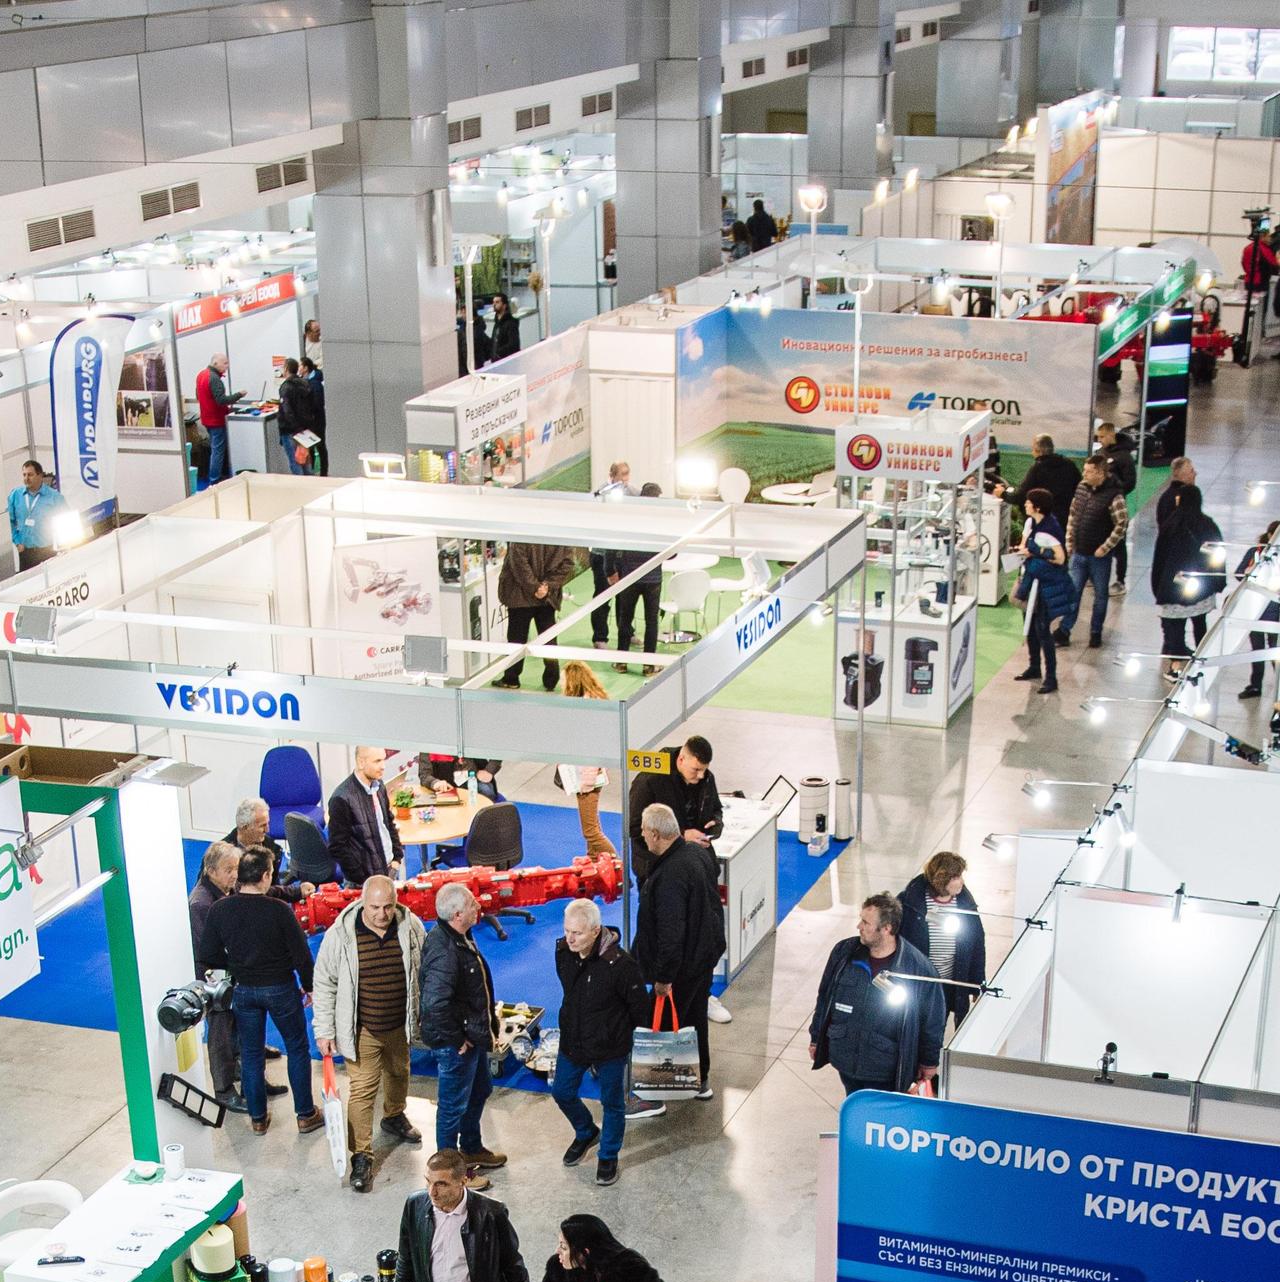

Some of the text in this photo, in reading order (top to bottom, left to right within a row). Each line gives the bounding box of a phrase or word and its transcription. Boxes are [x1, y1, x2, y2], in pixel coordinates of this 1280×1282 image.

[178, 304, 202, 331] MAX
[868, 345, 923, 355] решения
[927, 348, 940, 357] за
[465, 398, 500, 423] Резервни
[552, 407, 584, 438] TOPCON
[736, 597, 781, 655] VESIDON
[865, 1122, 1071, 1175] ПОРТФОЛИО
[1079, 1155, 1124, 1182] ОТ
[1084, 1192, 1211, 1238] КРИСТА
[878, 1235, 1111, 1282] ВИТАМИННО-МИНЕРАЛНИ ПРЕМИКСИ
[878, 1249, 904, 1264] СЪС
[907, 1253, 916, 1266] И
[919, 1256, 942, 1270] БЕЗ
[945, 1260, 997, 1279] ЕНЗИМИ
[1000, 1268, 1009, 1280] И
